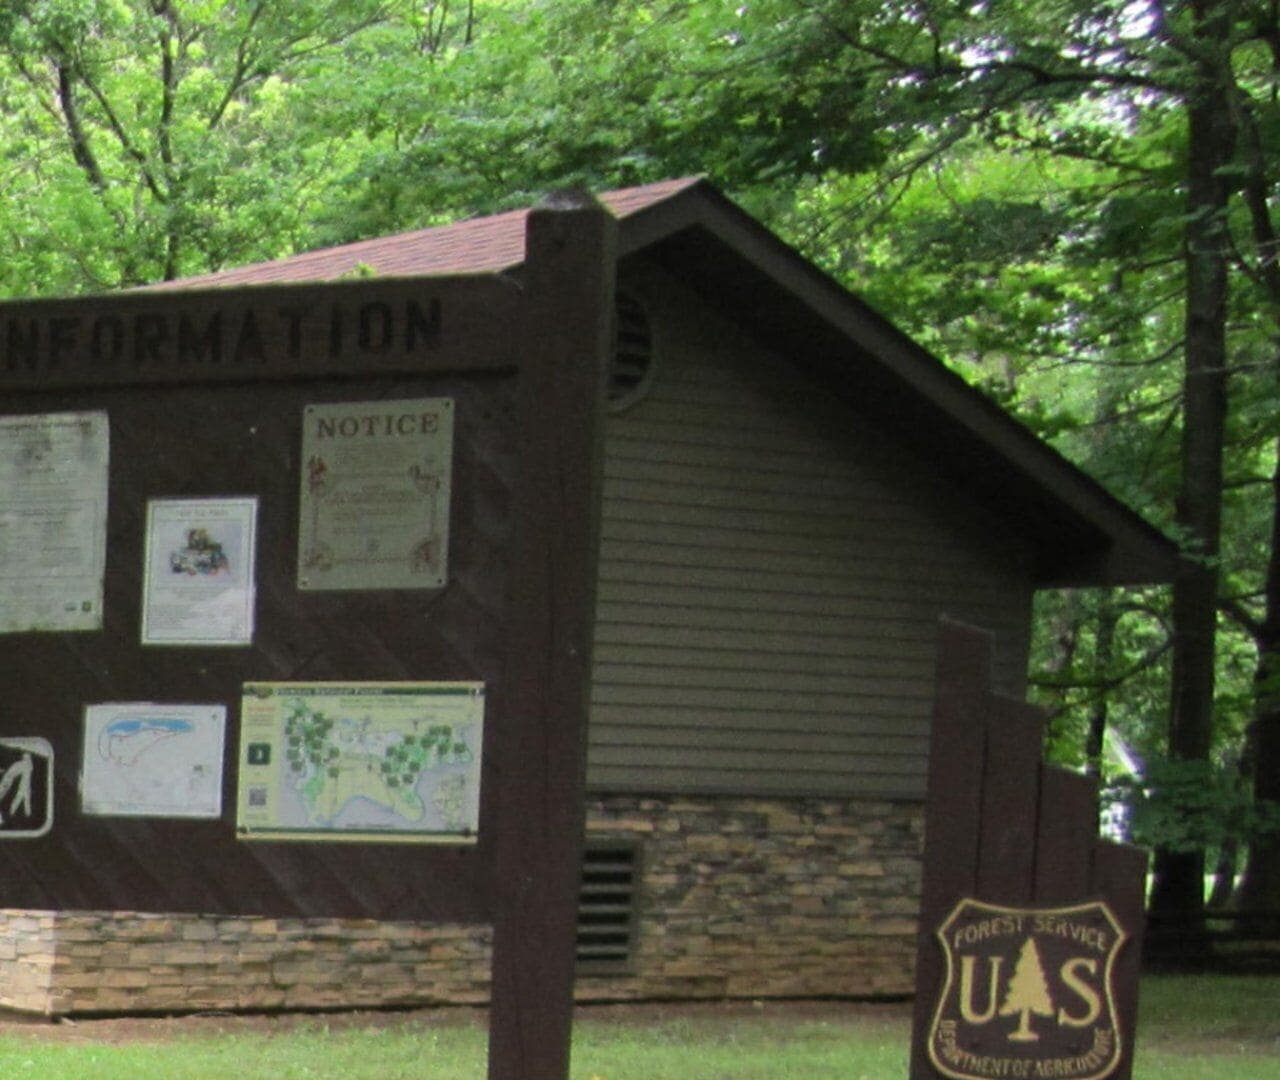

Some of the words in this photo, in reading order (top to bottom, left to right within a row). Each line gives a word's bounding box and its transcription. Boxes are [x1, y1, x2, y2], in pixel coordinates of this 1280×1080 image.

[317, 412, 439, 439] NOTICE
[953, 917, 1024, 949] FOREST
[1033, 916, 1107, 951] SERVICE
[939, 1020, 1010, 1077] DEPARTMENT
[1012, 1058, 1033, 1077] OF
[1036, 1027, 1113, 1077] AGRICULTURE
